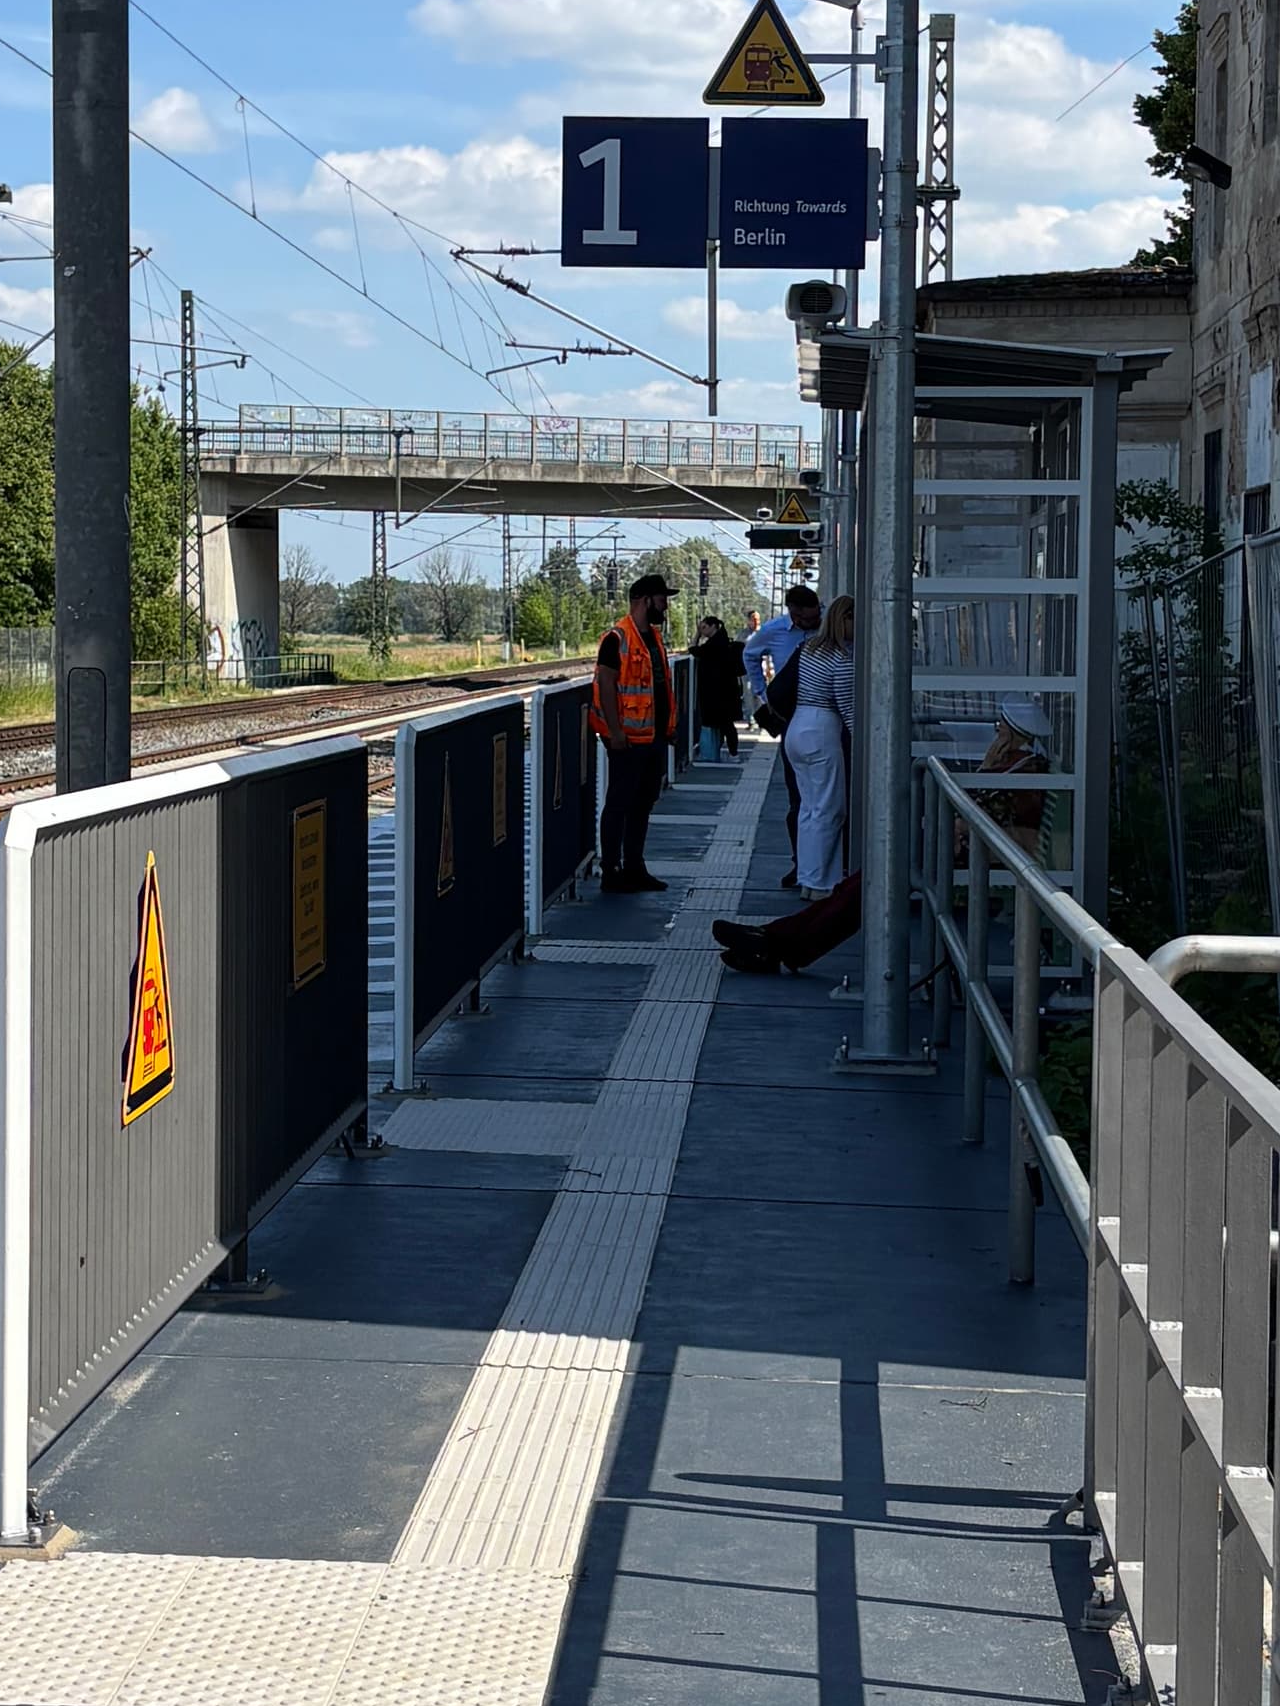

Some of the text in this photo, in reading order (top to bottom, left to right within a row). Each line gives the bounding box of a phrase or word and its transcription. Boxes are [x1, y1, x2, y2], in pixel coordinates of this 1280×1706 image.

[577, 138, 638, 246] 1
[734, 198, 847, 216] Richtung Towards
[733, 228, 786, 246] Berlin
